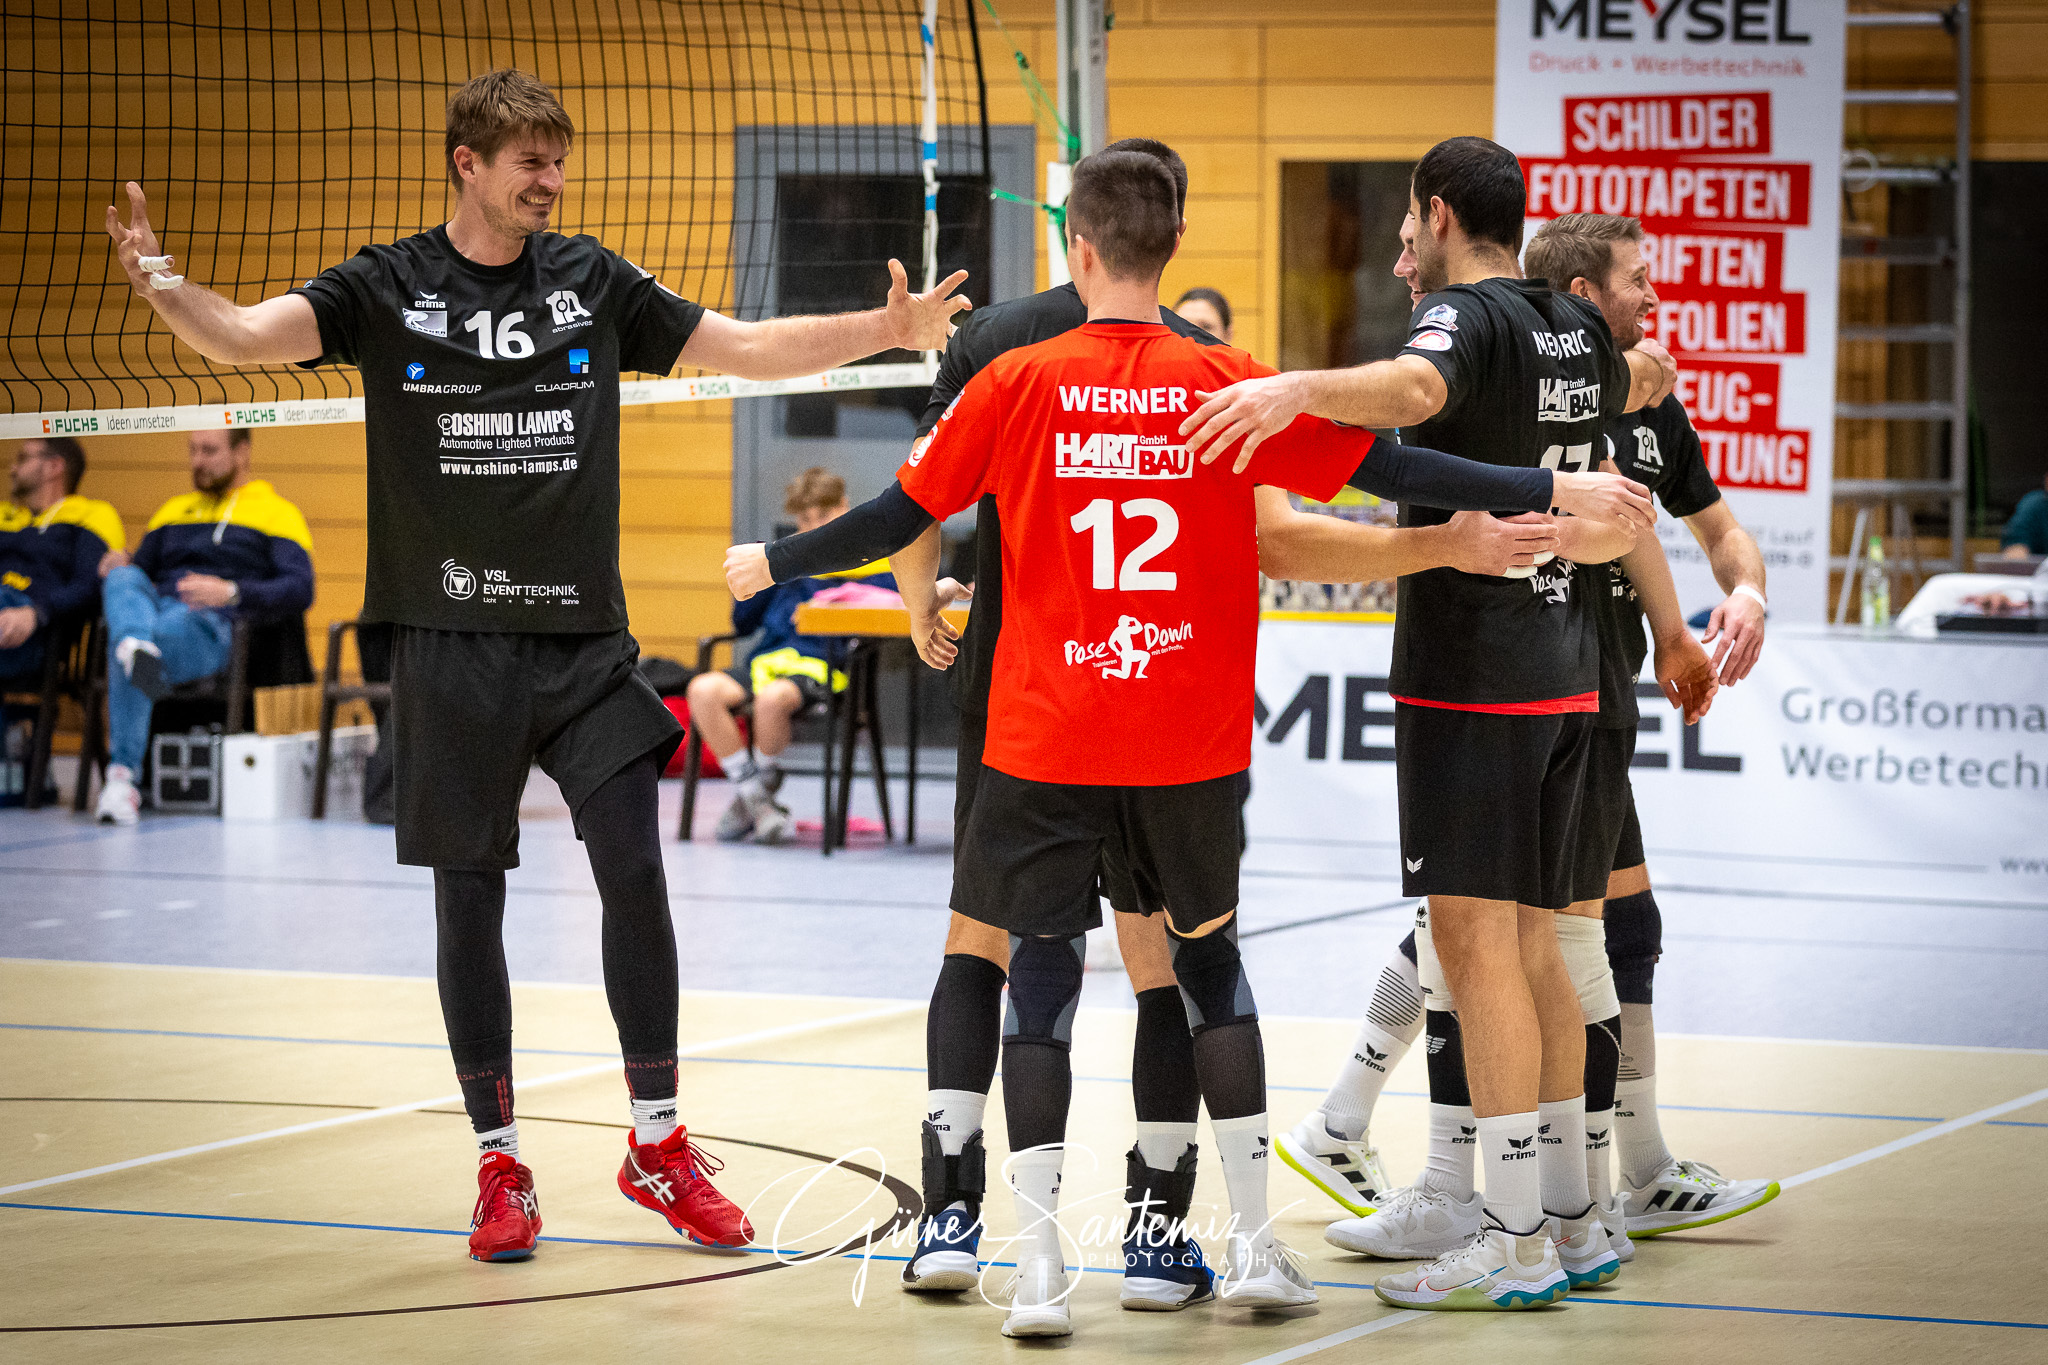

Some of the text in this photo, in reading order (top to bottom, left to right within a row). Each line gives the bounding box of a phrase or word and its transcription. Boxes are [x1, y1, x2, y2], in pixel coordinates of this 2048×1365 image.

[1532, 0, 1811, 43] MEYSEL
[1529, 51, 1806, 78] Druck Werbetechnik
[1572, 99, 1758, 152] SCHILDER
[1529, 163, 1791, 221] FOTOTAPETEN
[1639, 233, 1767, 289] RIFTEN
[414, 300, 446, 308] erima
[464, 310, 536, 359] 16
[552, 320, 593, 334] abrasives
[1645, 300, 1788, 352] FOLIEN
[403, 382, 482, 394] UMBRAGROUP
[1058, 385, 1189, 414] WERNER
[1673, 369, 1774, 424] EUG-
[55, 413, 176, 433] FUCHS Ideen umsetzen
[236, 406, 348, 424] FUCHS Ideen umsetzen
[452, 409, 575, 436] OSHINO LAMPS
[439, 434, 575, 451] Automotive Lighted Products
[1055, 432, 1191, 477] HART BAU
[1139, 435, 1168, 445] GmbH
[440, 457, 578, 475] www.oshino-lamps.de
[1700, 430, 1805, 487] TUNG
[1070, 498, 1179, 591] 12
[484, 569, 511, 582] VSL
[1063, 620, 1193, 666] Pose Down
[1781, 686, 2048, 732] Großforma
[1781, 744, 2048, 789] Werbetech
[1354, 1052, 1386, 1073] erima
[1502, 1150, 1536, 1161] erima
